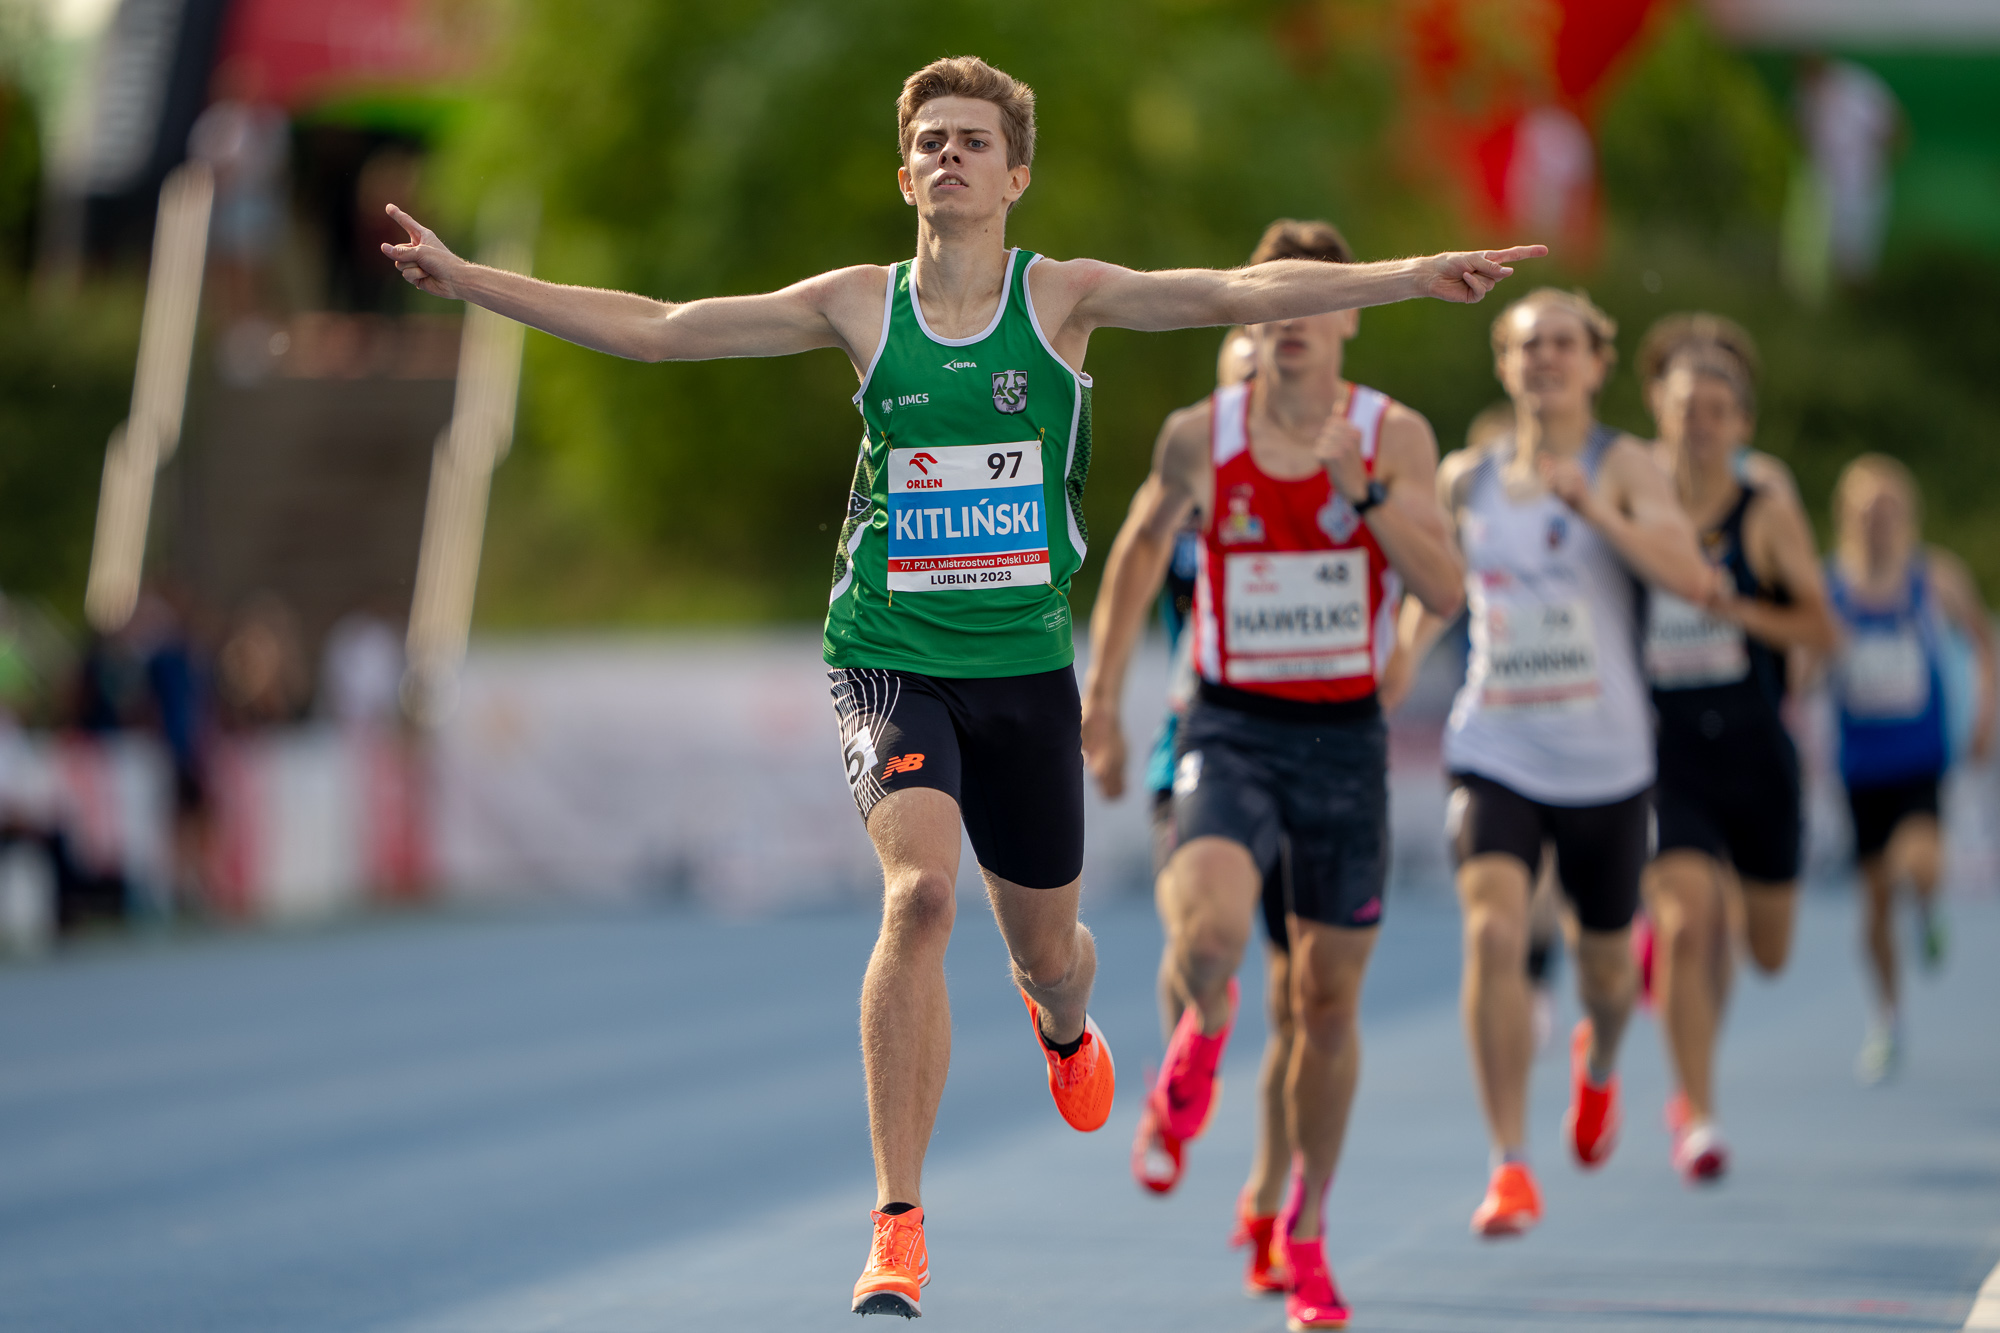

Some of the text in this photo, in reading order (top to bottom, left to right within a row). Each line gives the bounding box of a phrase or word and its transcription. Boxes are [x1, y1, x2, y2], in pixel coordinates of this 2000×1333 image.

[898, 393, 930, 406] UMCS
[987, 451, 1023, 480] 97
[906, 478, 943, 489] ORLEN
[895, 498, 1040, 540] KITLIŃSKI
[900, 553, 1040, 571] 77. PZLA Mistrzostwa Polski U20
[930, 570, 1012, 585] LUBLIN 2023
[844, 737, 865, 785] 5
